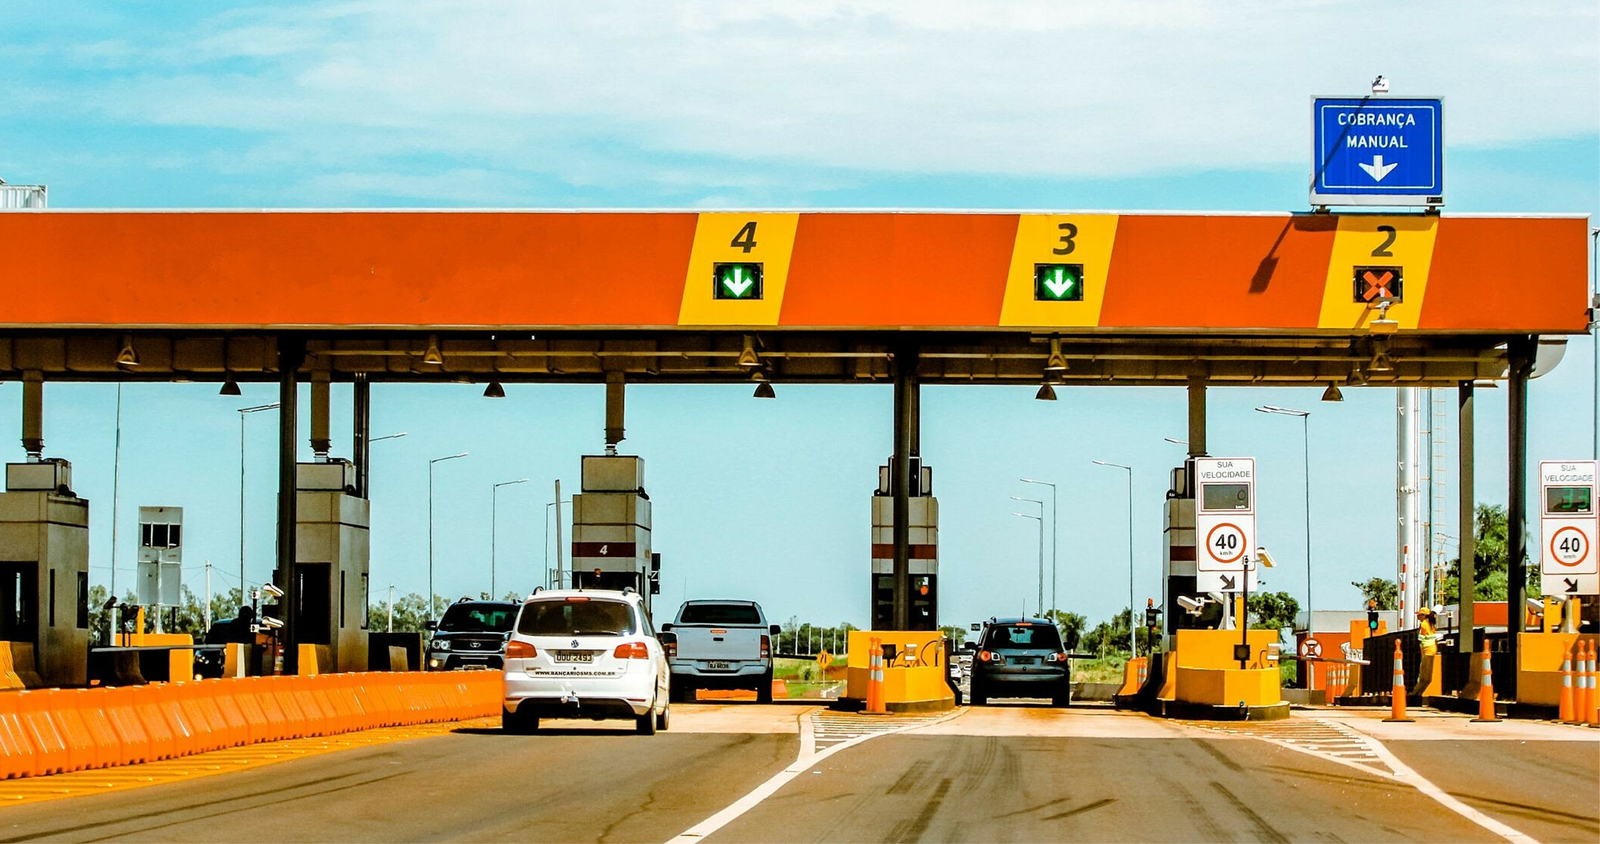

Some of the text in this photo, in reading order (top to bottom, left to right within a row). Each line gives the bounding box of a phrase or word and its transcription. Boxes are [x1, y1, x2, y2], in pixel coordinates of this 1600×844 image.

[1338, 113, 1415, 129] COBRANÇA
[1347, 135, 1408, 149] MANUAL
[730, 221, 758, 254] 4
[1053, 223, 1078, 256] 3
[1371, 225, 1397, 257] 2
[1217, 461, 1233, 469] SUA
[1201, 471, 1251, 479] VELOCIDADE
[1562, 488, 1589, 508] 33
[599, 544, 608, 555] 4
[1215, 534, 1237, 550] 40
[1559, 537, 1580, 553] 40
